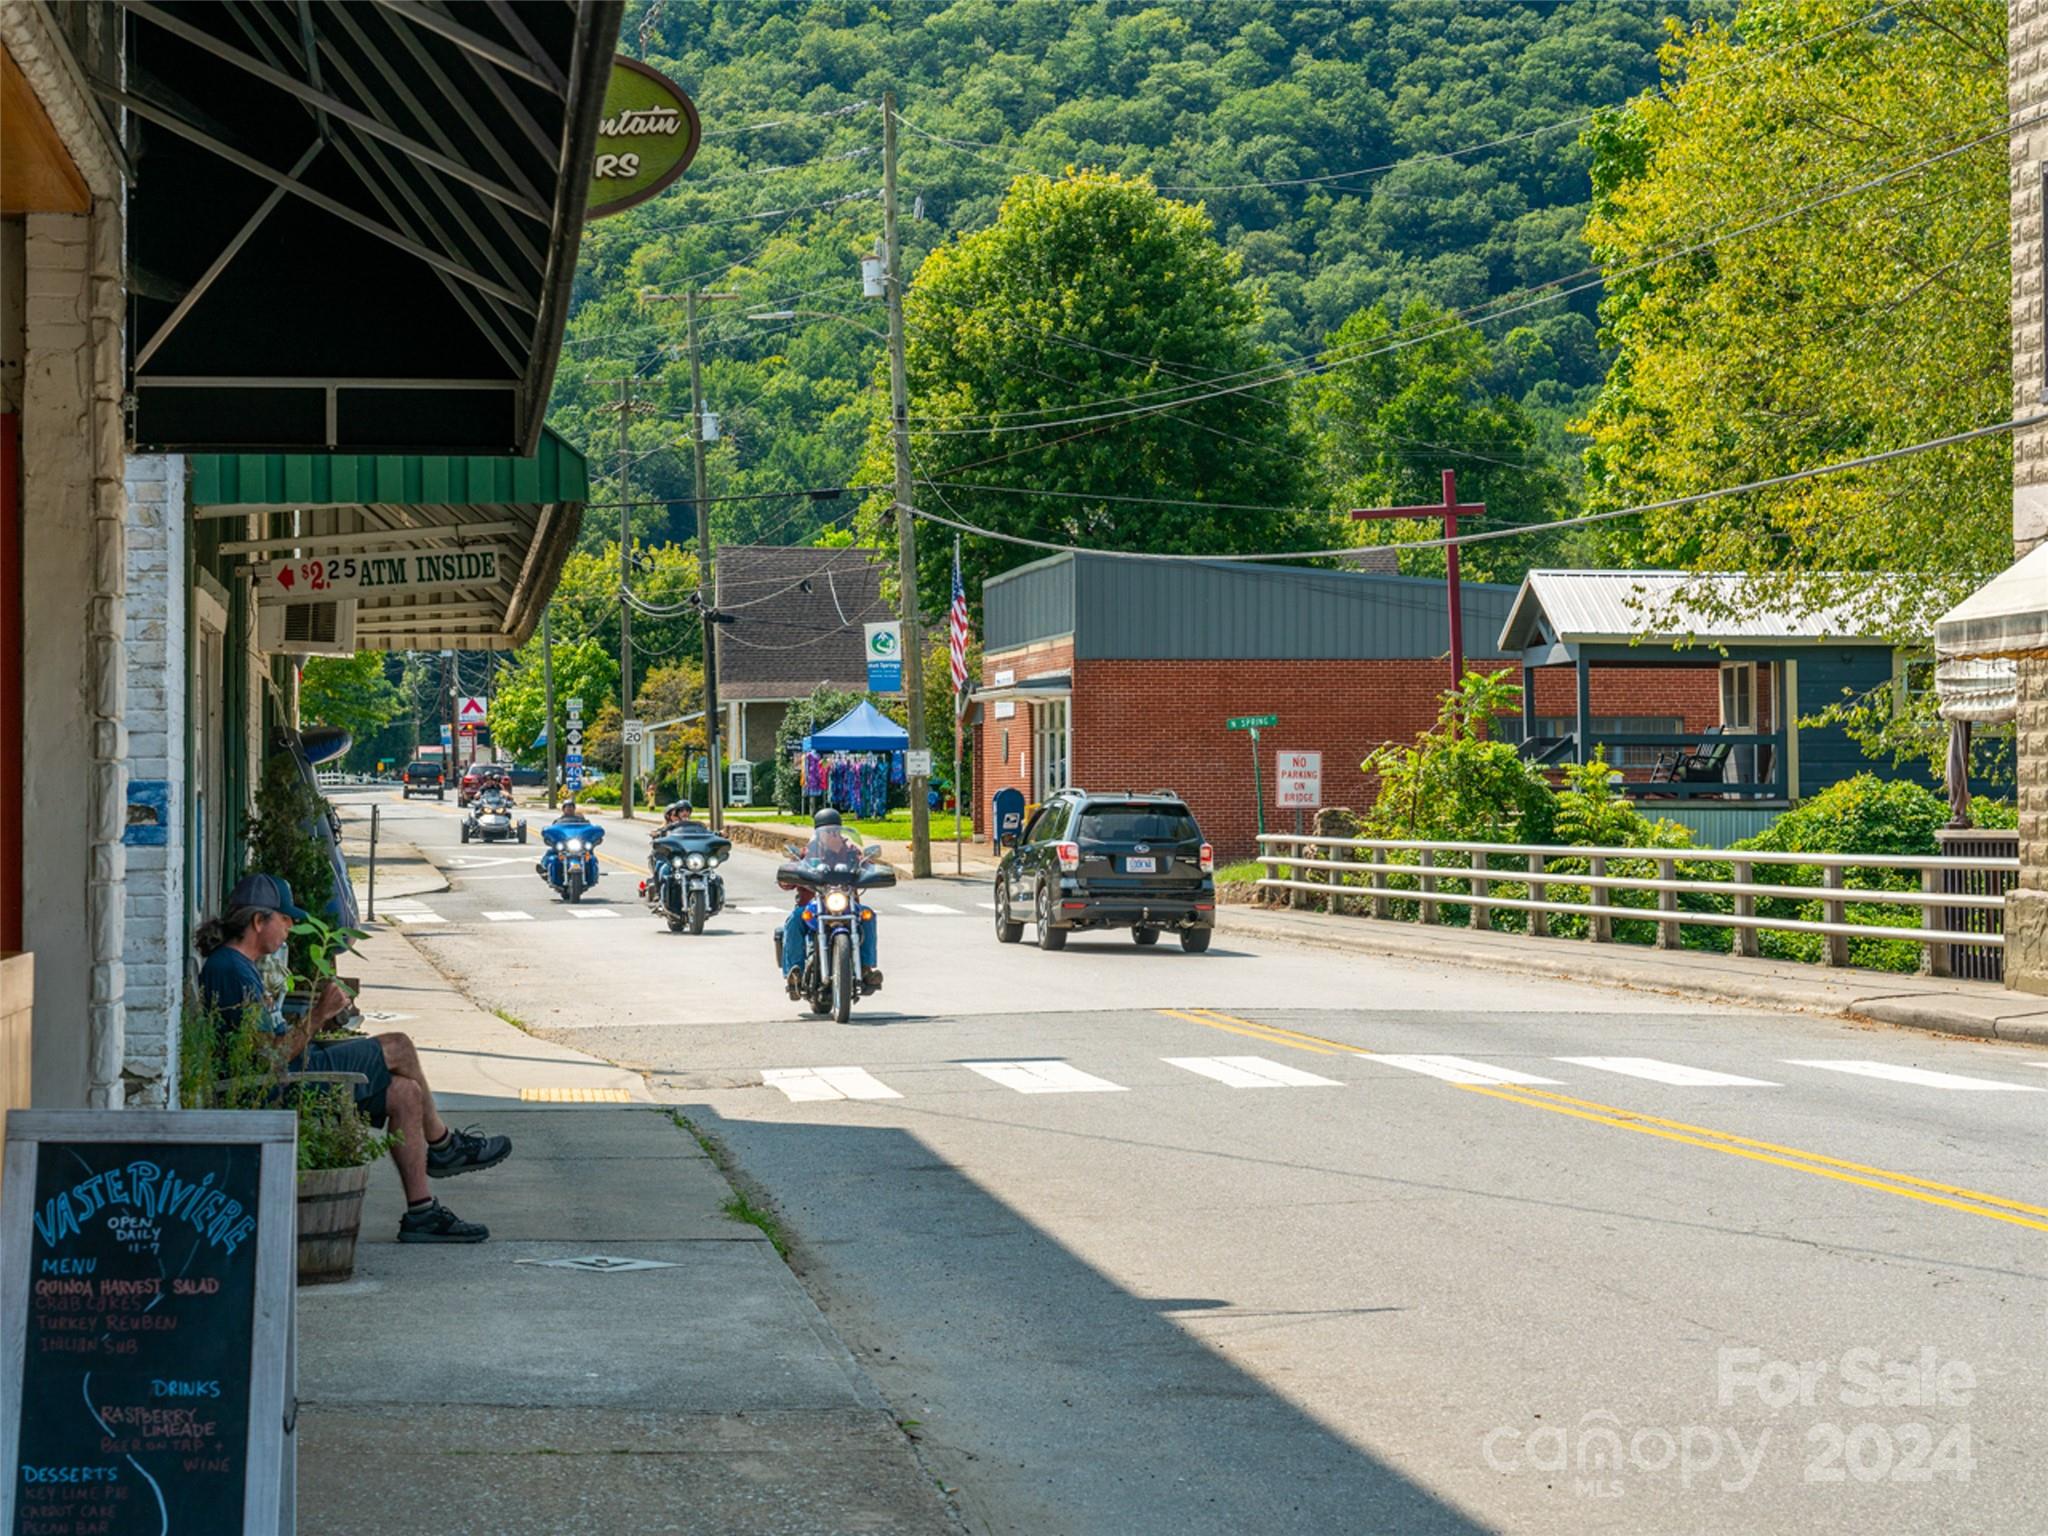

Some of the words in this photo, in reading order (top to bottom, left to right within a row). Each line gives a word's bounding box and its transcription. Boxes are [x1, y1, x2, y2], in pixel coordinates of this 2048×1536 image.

[359, 558, 408, 586] ATM
[416, 552, 496, 583] INSIDE
[1241, 717, 1269, 727] SPRING
[625, 732, 641, 742] 20
[1292, 757, 1307, 767] NO
[567, 767, 582, 776] 40
[1281, 770, 1318, 779] PARKING
[1294, 782, 1305, 790] ON
[1284, 793, 1314, 802] BRIDGE
[107, 1216, 153, 1230] OPEN
[116, 1228, 161, 1242] DAILY
[42, 1258, 97, 1275] MENU
[35, 1279, 94, 1297] QUINOA
[101, 1278, 162, 1295] HARVEST
[173, 1278, 220, 1295] SALAD
[37, 1315, 99, 1332] TURKEY
[151, 1379, 221, 1398] DRINKS
[100, 1406, 197, 1425] RASPBERRY
[142, 1421, 216, 1438] LIMEADE
[183, 1457, 230, 1473] WINE
[21, 1464, 118, 1483] DESSERTS
